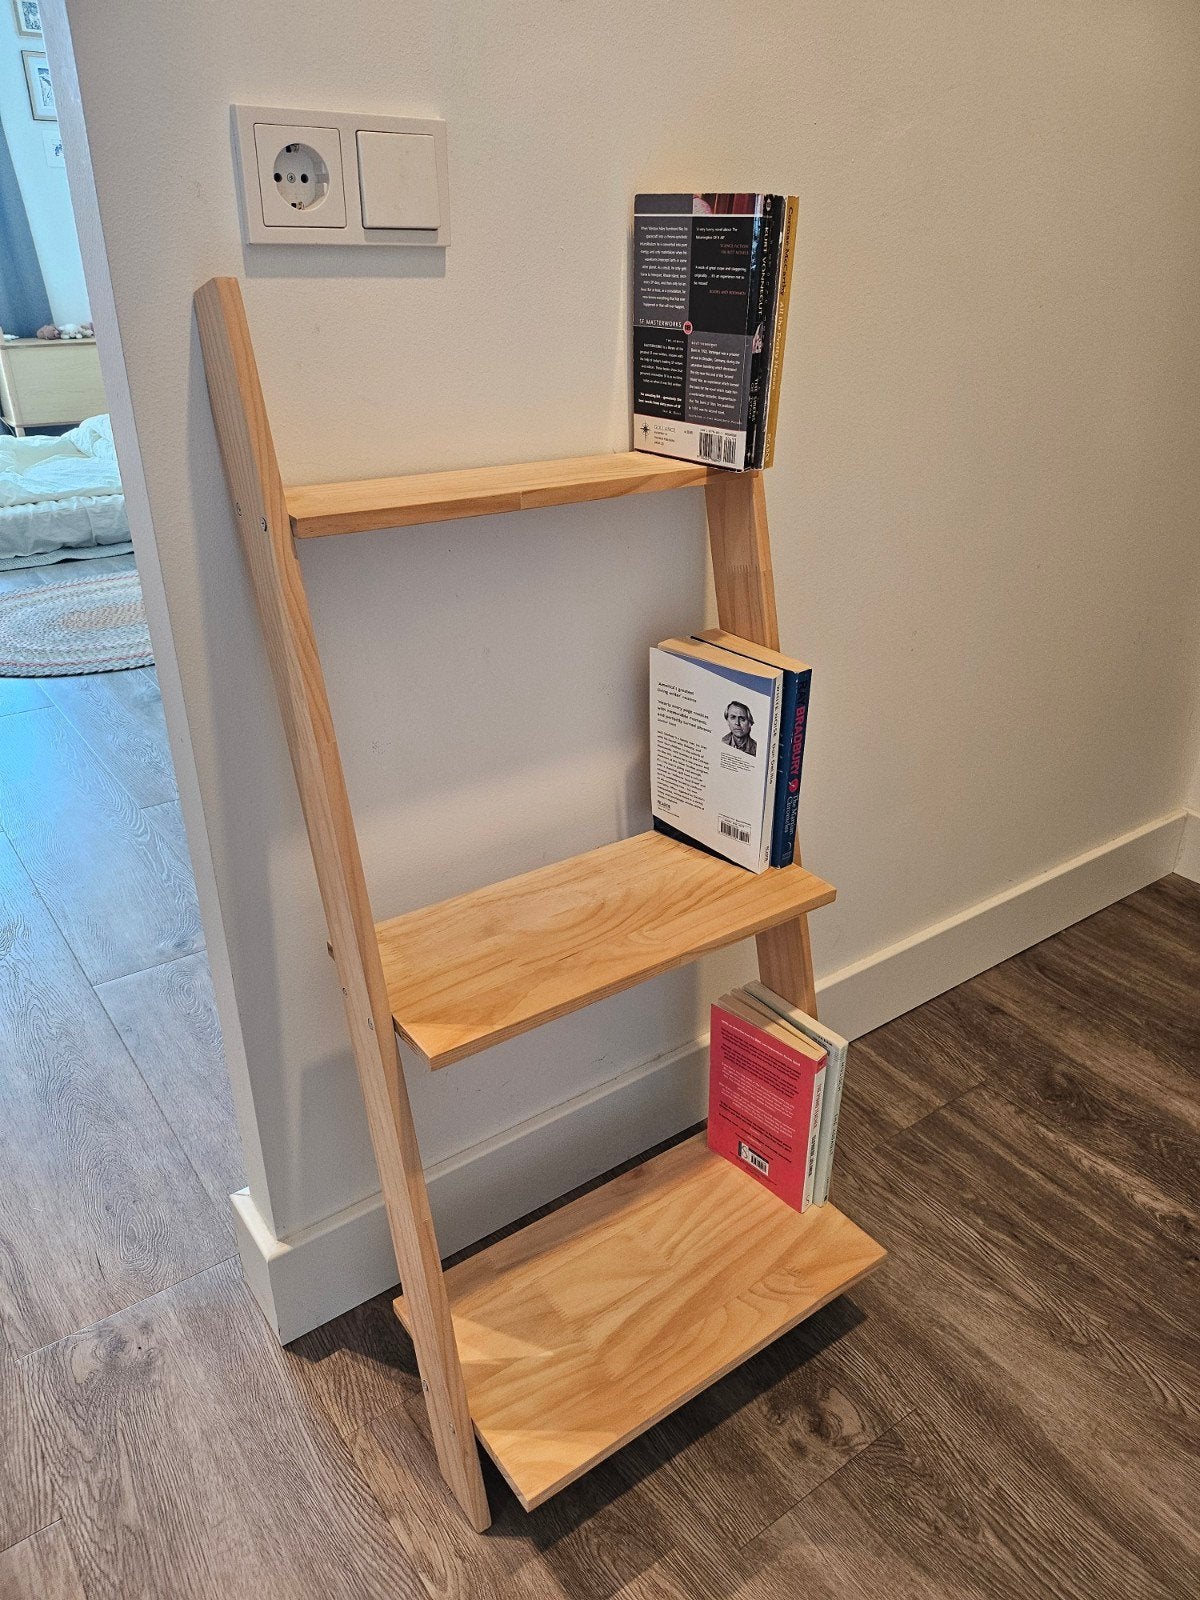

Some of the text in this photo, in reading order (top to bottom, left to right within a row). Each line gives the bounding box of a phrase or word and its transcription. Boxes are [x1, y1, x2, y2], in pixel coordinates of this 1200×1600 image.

[758, 256, 767, 317] VONNEGUT
[781, 248, 790, 296] McCarthy
[646, 319, 682, 328] MASTERWORKS
[791, 705, 806, 776] BRADBURY
